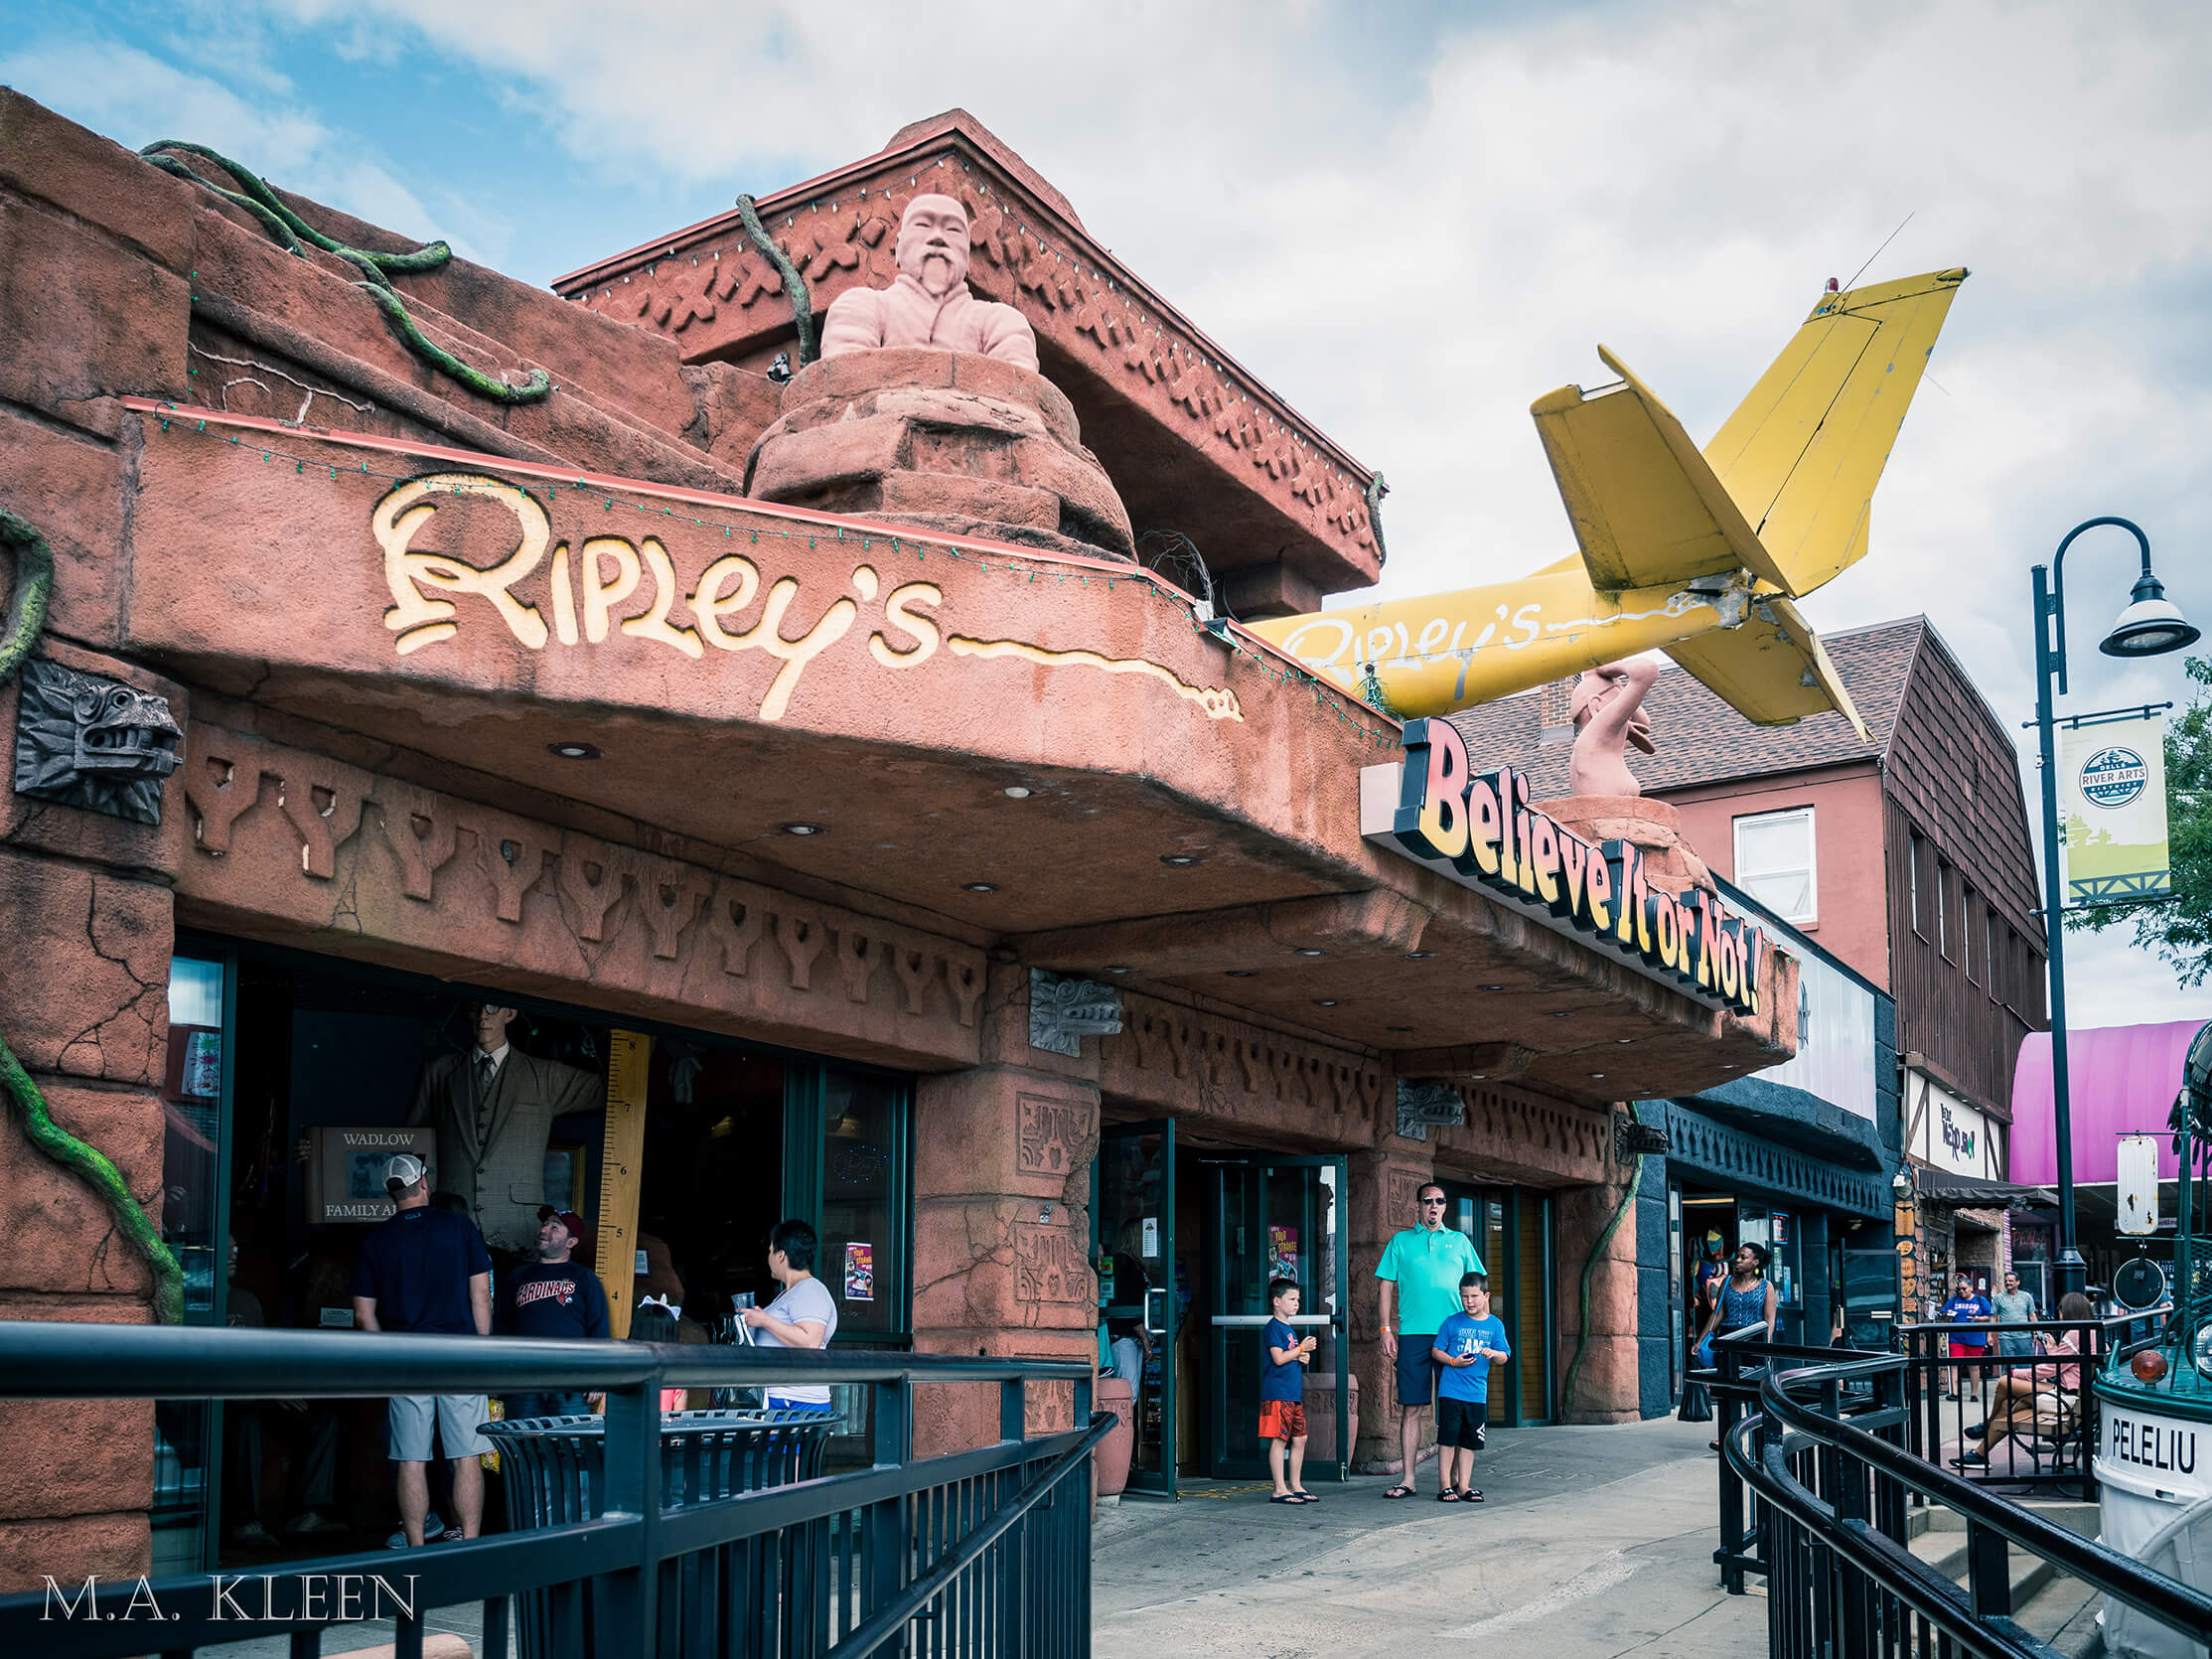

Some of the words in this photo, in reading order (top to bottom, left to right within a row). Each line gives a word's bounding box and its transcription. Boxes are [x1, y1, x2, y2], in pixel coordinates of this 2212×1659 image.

[2082, 772, 2115, 786] RIVER
[2118, 768, 2145, 781] ARTS
[1410, 716, 1612, 931] Believe
[1615, 840, 1652, 954] It
[1657, 892, 1695, 976] or
[1697, 889, 1764, 1016] Not!
[629, 1040, 636, 1050] 8
[625, 1103, 631, 1113] 7
[344, 1133, 414, 1145] WADLOW
[620, 1164, 628, 1175] 6
[325, 1204, 379, 1217] FAMILY
[615, 1228, 623, 1238] 5
[611, 1290, 619, 1300] 4
[2113, 1418, 2196, 1474] PELELIU
